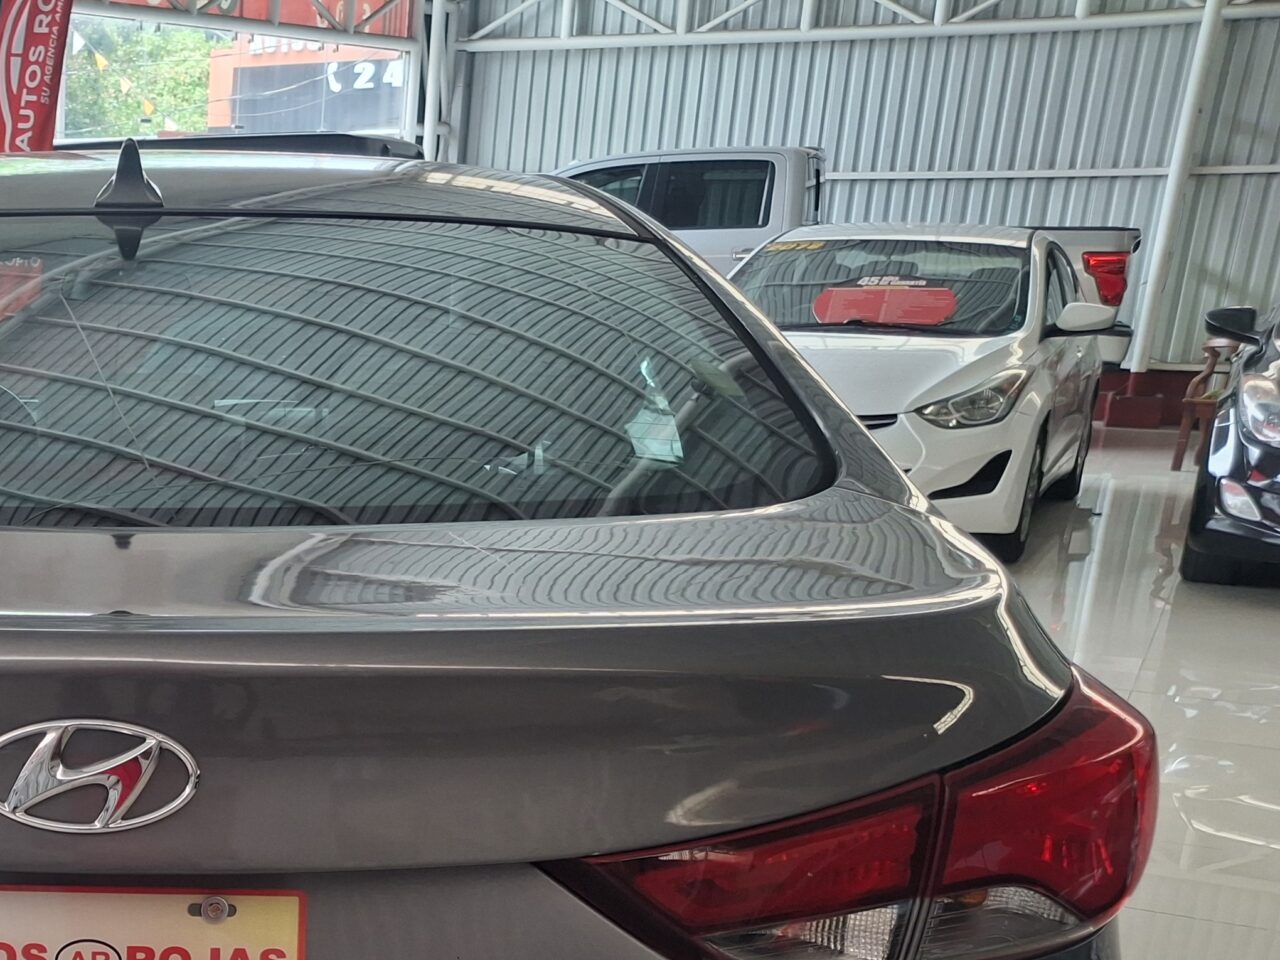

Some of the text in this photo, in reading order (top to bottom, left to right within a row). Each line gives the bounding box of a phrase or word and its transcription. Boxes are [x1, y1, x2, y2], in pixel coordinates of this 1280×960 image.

[43, 26, 59, 84] AGENCIA
[15, 45, 45, 152] AUTOS
[40, 87, 51, 105] SU
